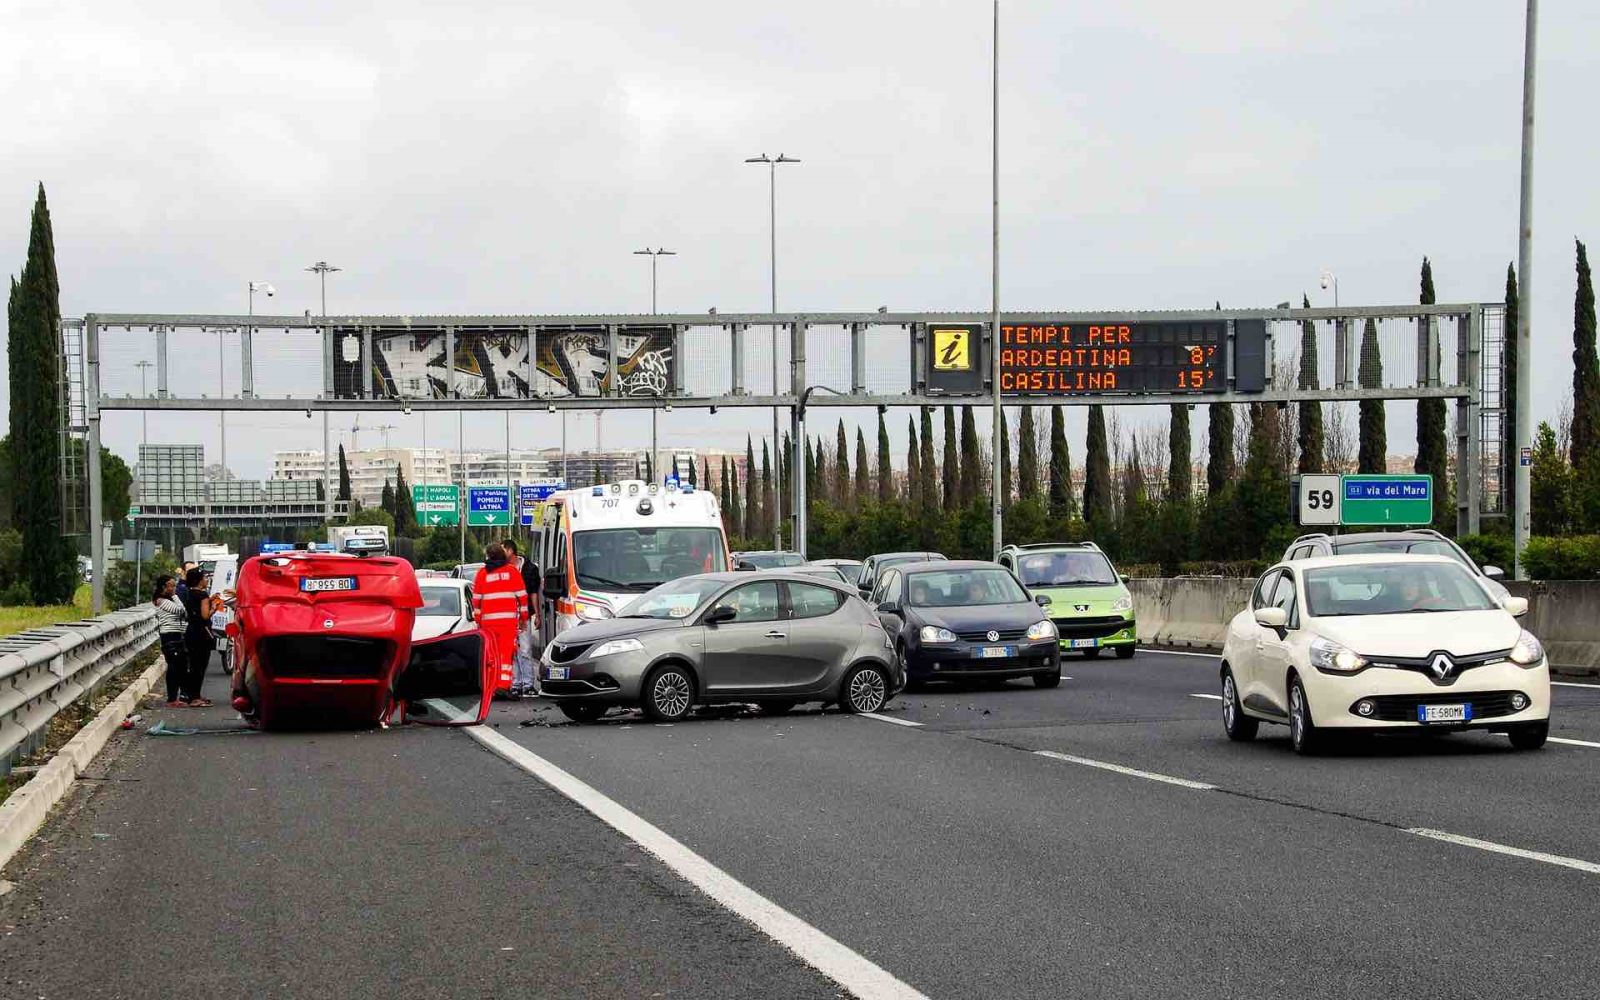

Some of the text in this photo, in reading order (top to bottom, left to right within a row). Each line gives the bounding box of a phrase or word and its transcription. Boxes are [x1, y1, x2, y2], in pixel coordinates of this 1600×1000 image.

[1002, 326, 1131, 343] TEMPI PER
[1002, 349, 1131, 367] ARDEATINA
[1002, 372, 1117, 390] CASILINA
[1366, 486, 1380, 495] via
[1385, 486, 1399, 495] del
[1403, 486, 1426, 495] Mare
[601, 498, 620, 509] 707
[1308, 489, 1334, 510] 59
